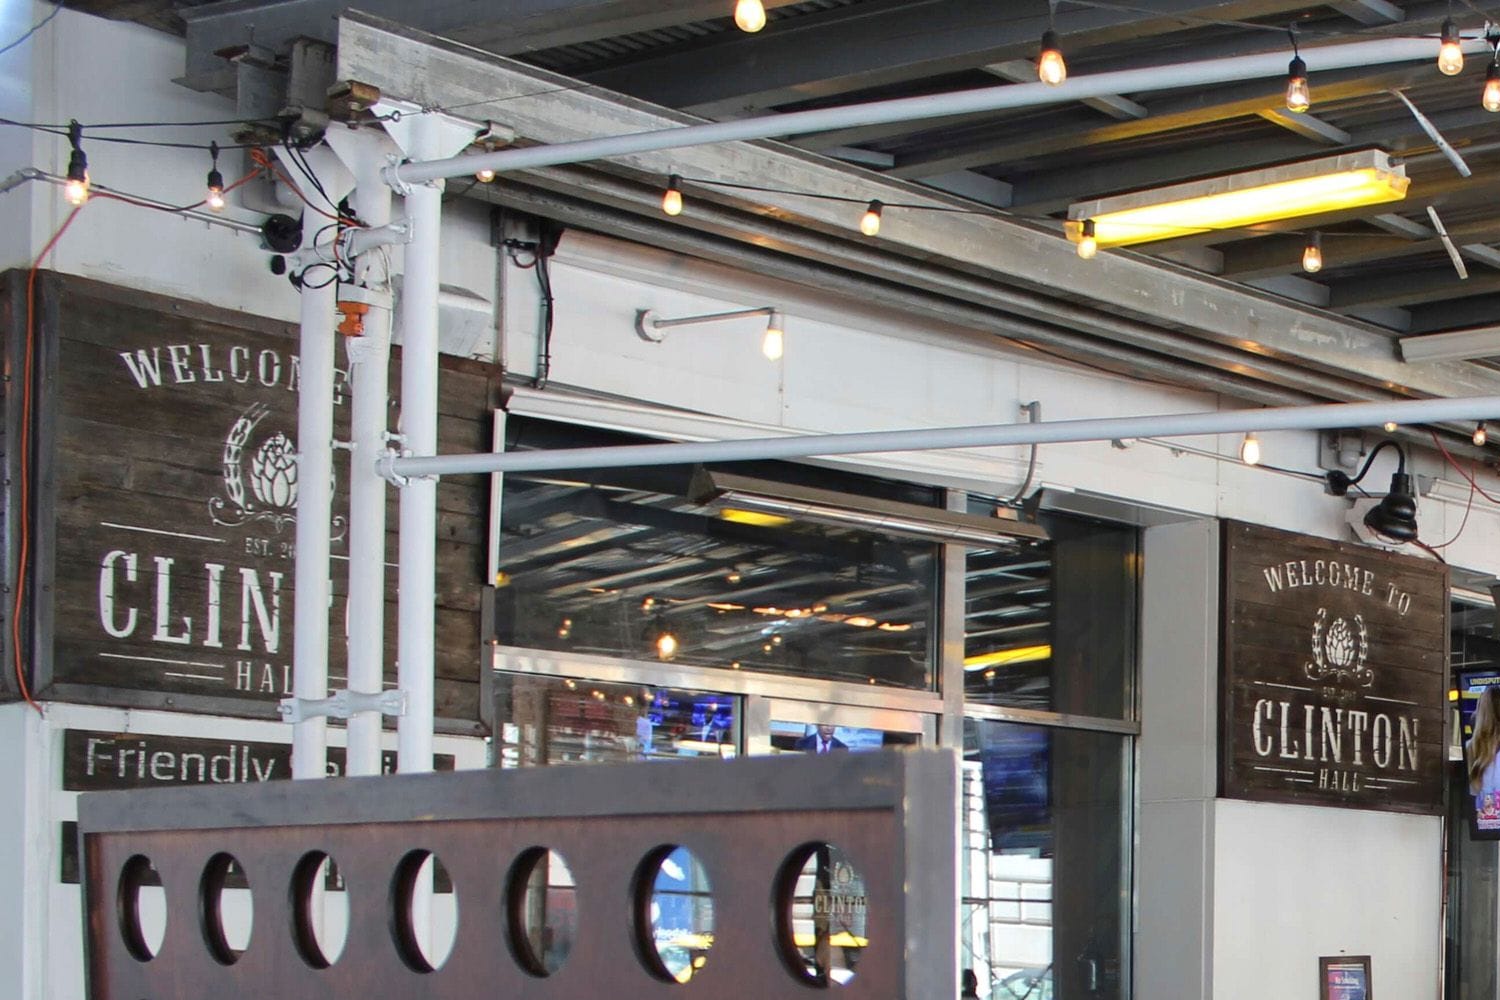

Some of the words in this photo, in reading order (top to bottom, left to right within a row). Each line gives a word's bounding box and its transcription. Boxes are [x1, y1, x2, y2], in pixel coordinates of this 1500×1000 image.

[120, 343, 349, 405] WELCOE
[100, 550, 284, 654] CLIN
[1263, 559, 1375, 597] WELCOME
[1386, 582, 1412, 617] TO
[235, 660, 295, 694] HAL
[86, 737, 276, 784] Friendly
[1253, 698, 1420, 771] CLINTON
[1318, 768, 1361, 793] HALL
[814, 894, 867, 914] CLINTO
